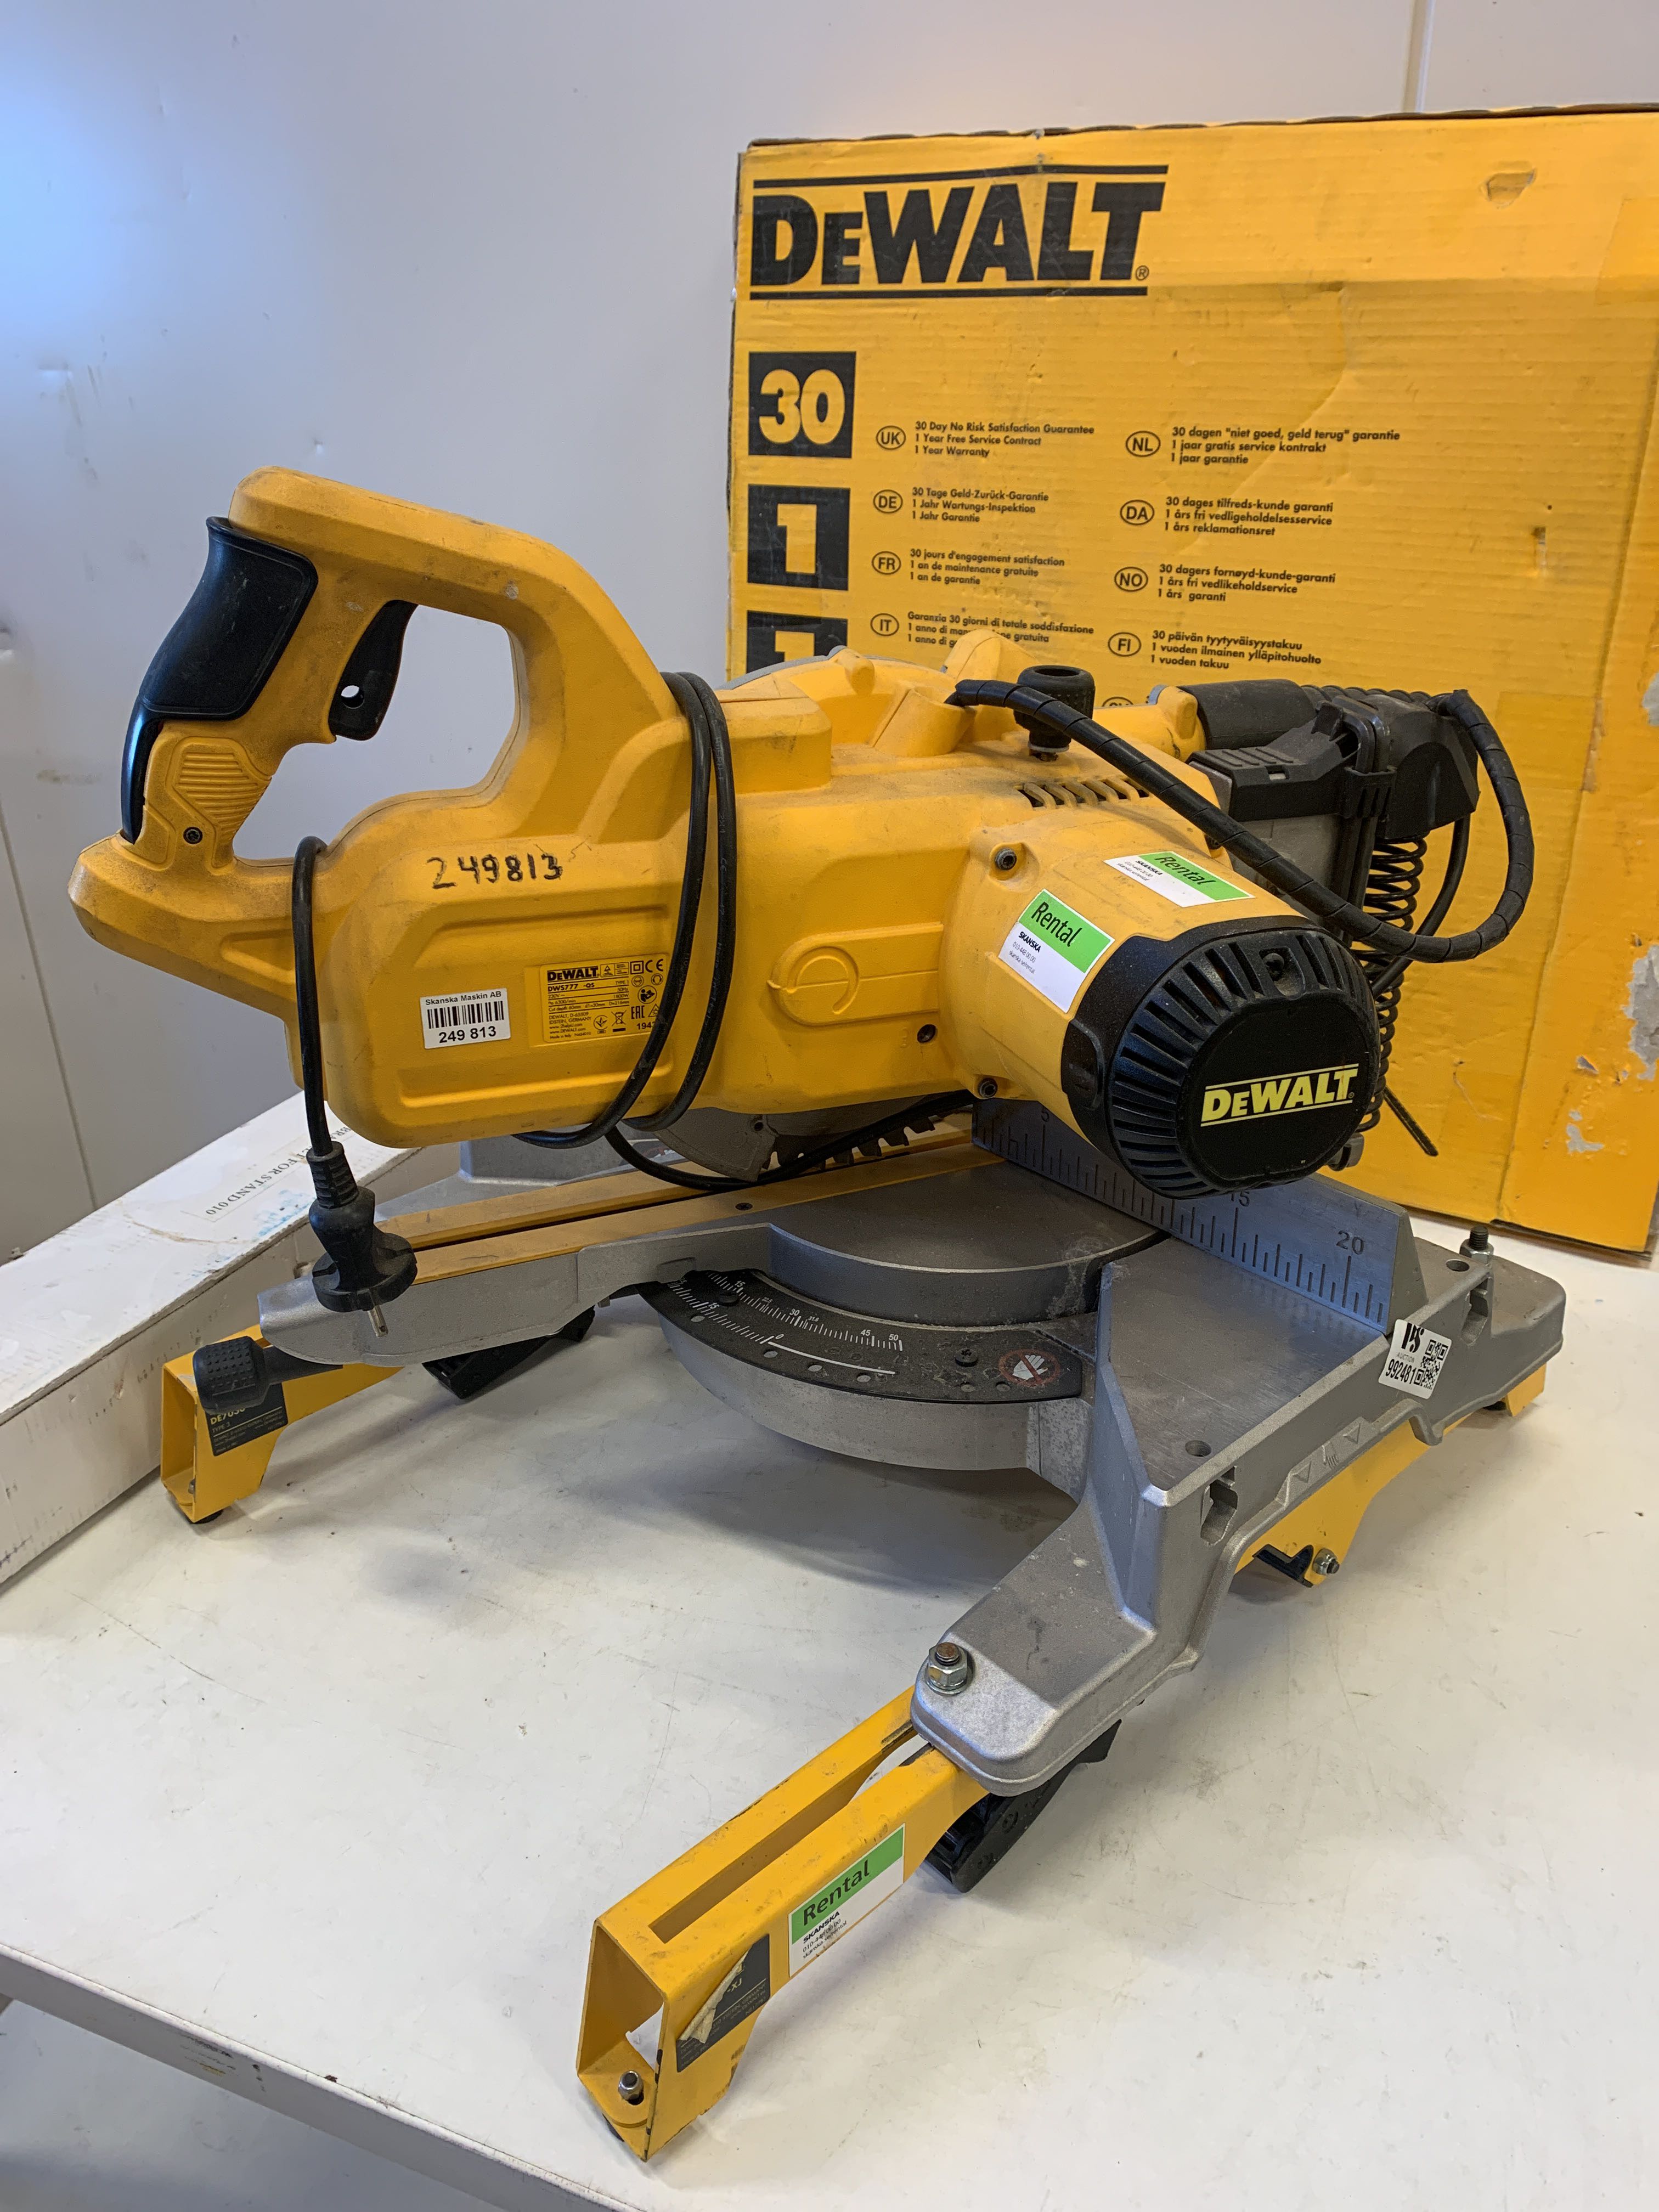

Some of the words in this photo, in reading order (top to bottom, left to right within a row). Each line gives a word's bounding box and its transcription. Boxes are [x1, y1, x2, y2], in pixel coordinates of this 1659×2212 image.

[759, 369, 845, 444] 30
[915, 421, 927, 430] 30
[929, 421, 947, 433] Day
[950, 422, 963, 431] No
[967, 422, 985, 431] Risk
[988, 422, 1040, 432] Satisfaction
[1043, 424, 1094, 434] Guarantee
[1172, 426, 1186, 436] 30
[1189, 426, 1222, 439] dagen
[1288, 428, 1312, 441] geld
[1352, 430, 1400, 442] garantie
[881, 431, 900, 445] UK
[916, 433, 919, 442] 1
[923, 433, 944, 442] Year
[947, 434, 966, 443] Free
[969, 435, 1001, 444] Service
[1003, 435, 1041, 445] Contract
[1132, 437, 1153, 452] NL
[915, 445, 918, 454] 1
[923, 445, 943, 454] Year
[946, 446, 990, 458] Warranty
[1172, 439, 1176, 449] 1
[1181, 439, 1201, 452] jaar
[1205, 441, 1235, 452] gratis
[1239, 441, 1276, 452] service
[1279, 441, 1327, 452] kontrakt
[1171, 453, 1175, 462] 1
[1180, 452, 1200, 465] jaar
[1204, 454, 1249, 465] garantie
[912, 487, 924, 496] 30
[927, 488, 947, 499] Tage
[878, 495, 897, 509] DE
[913, 499, 916, 507] 1
[920, 499, 939, 508] Jahr
[943, 500, 1035, 514] Wartungs-Inspektion
[1166, 496, 1180, 506] 30
[1182, 498, 1213, 510] dages
[1217, 498, 1290, 510] tilfreds-kunde
[1294, 502, 1333, 514] garanti
[912, 510, 916, 519] 1
[919, 511, 939, 520] Jahr
[941, 512, 980, 522] Garantie
[1126, 506, 1148, 520] DA
[1166, 509, 1170, 518] 1
[1175, 509, 1190, 519] års
[1194, 510, 1206, 520] fri
[1165, 522, 1169, 531] 1
[1173, 522, 1189, 532] års
[1193, 522, 1276, 535] reklamationsret
[777, 504, 817, 574] 1
[878, 557, 895, 570] FR
[910, 548, 922, 557] 30
[924, 549, 945, 560] jours
[948, 550, 1011, 563] d'engagement
[1013, 555, 1065, 566] satisfaction
[911, 560, 914, 568] 1
[932, 561, 942, 570] de
[945, 563, 1001, 574] maintenance
[1003, 567, 1039, 577] gratuite
[1159, 563, 1172, 573] 30
[1176, 565, 1210, 577] dagers
[910, 572, 913, 580] 1
[931, 573, 941, 582] de
[944, 575, 980, 585] garantie
[1120, 573, 1143, 587] NO
[1159, 576, 1163, 585] 1
[1167, 576, 1183, 586] års
[1187, 577, 1198, 588] fri
[1201, 579, 1297, 593] vedlikeholdservice
[1158, 588, 1162, 597] 1
[1166, 589, 1182, 599] års
[1189, 592, 1226, 602] garanti
[880, 619, 892, 631] IT
[907, 611, 946, 622] Garanzia
[949, 614, 960, 623] 30
[963, 616, 988, 627] giorni
[990, 618, 1000, 627] di
[1002, 619, 1027, 629] totale
[1030, 622, 1094, 634] soddisfazione
[939, 625, 947, 634] di
[908, 634, 911, 642] 1
[939, 636, 947, 645] di
[1014, 633, 1049, 642] gratuita
[1152, 630, 1165, 640] 30
[1168, 631, 1203, 642] päivän
[1118, 638, 1131, 652] FI
[1153, 642, 1156, 651] 1
[1161, 644, 1197, 654] vuoden
[1201, 645, 1245, 658] ilmainen
[1248, 650, 1322, 664] ylläpitohuolto
[1151, 654, 1155, 663] 1
[1159, 656, 1196, 666] vuoden
[1199, 658, 1229, 669] takuu
[427, 852, 563, 889] 249813
[1154, 856, 1216, 885] Rental
[1031, 901, 1082, 947] Rental
[1018, 931, 1041, 952] SKANSKA
[548, 984, 578, 992] DWS777
[425, 996, 459, 1006] Skanska
[461, 993, 488, 1002] Maskin
[490, 990, 502, 999] AB
[636, 1022, 656, 1030] 194
[439, 1028, 465, 1043] 249
[471, 1025, 497, 1040] 813
[268, 1158, 297, 1175] FOR
[227, 1174, 272, 1202] STAND
[206, 1201, 229, 1216] 010
[1336, 1229, 1364, 1255] 20
[1385, 1358, 1417, 1385] 992481
[803, 1859, 870, 1926] Rental
[803, 1911, 840, 1944] SKANSKA
